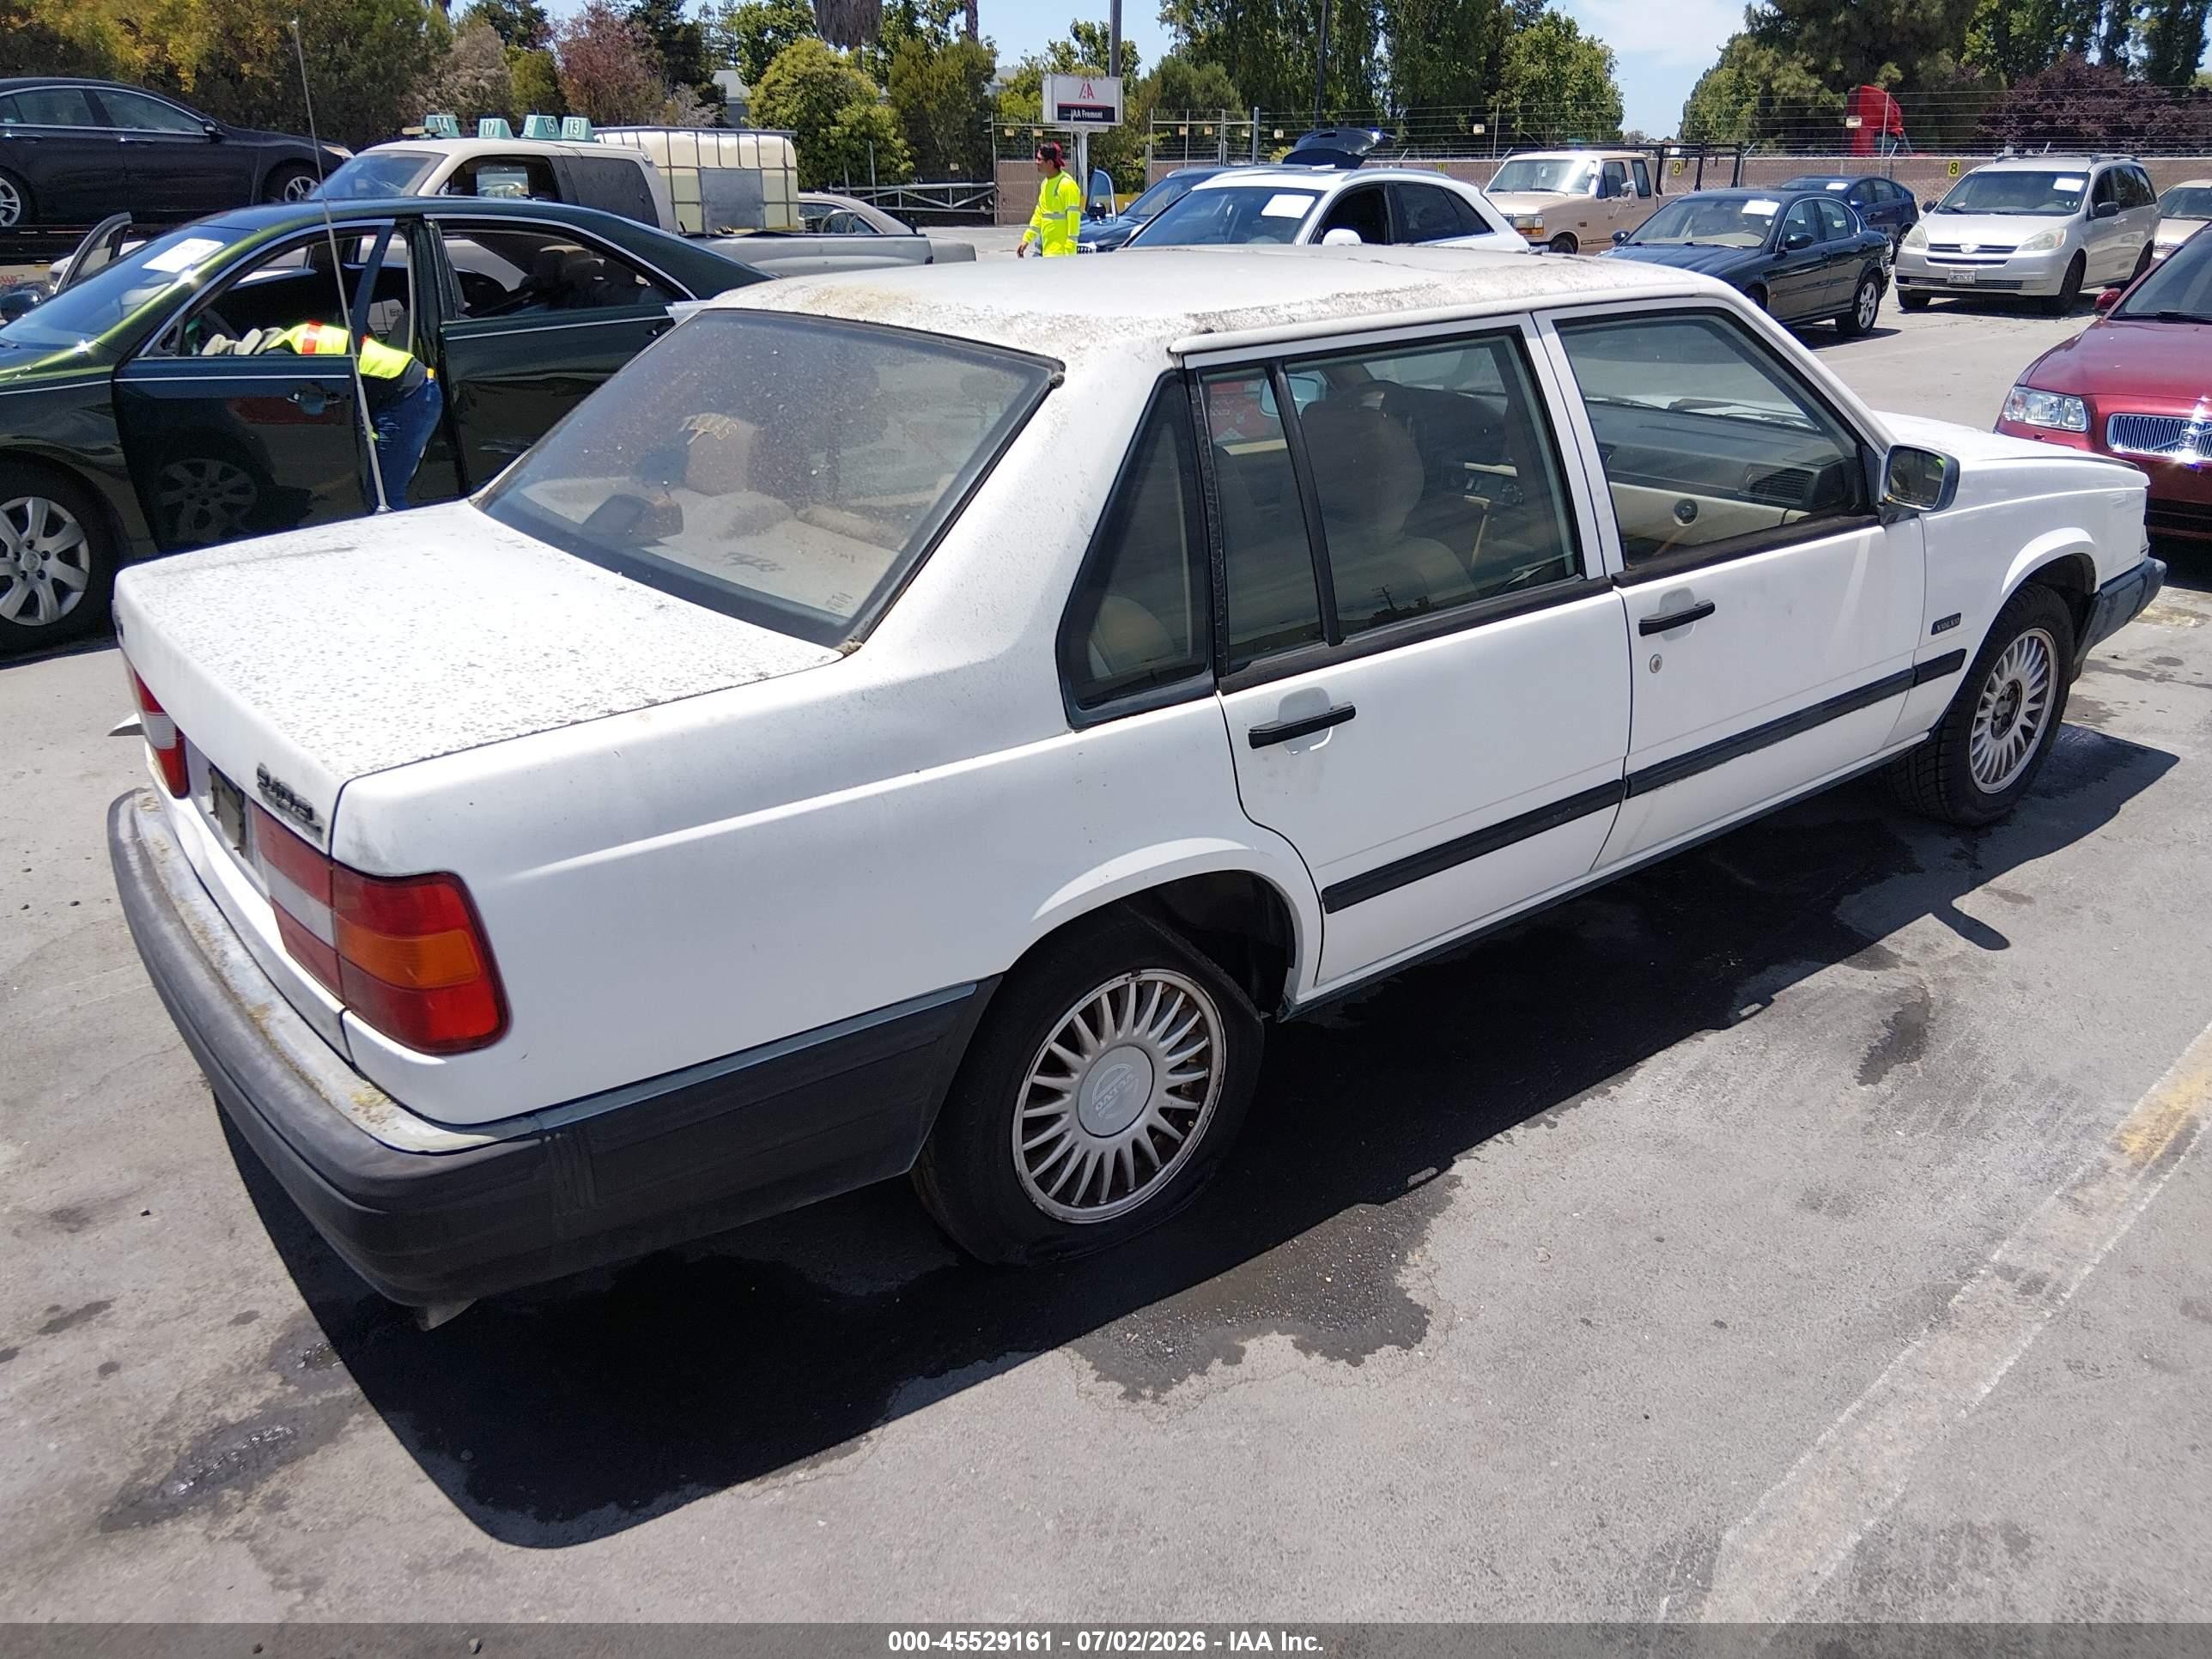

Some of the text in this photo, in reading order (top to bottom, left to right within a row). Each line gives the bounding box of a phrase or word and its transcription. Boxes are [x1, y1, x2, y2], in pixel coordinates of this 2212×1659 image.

[1082, 110, 1103, 119] Fremont
[436, 118, 451, 132] 14
[484, 120, 495, 136] 17
[544, 118, 556, 134] 15
[568, 119, 580, 135] 13
[1949, 161, 1960, 175] 8
